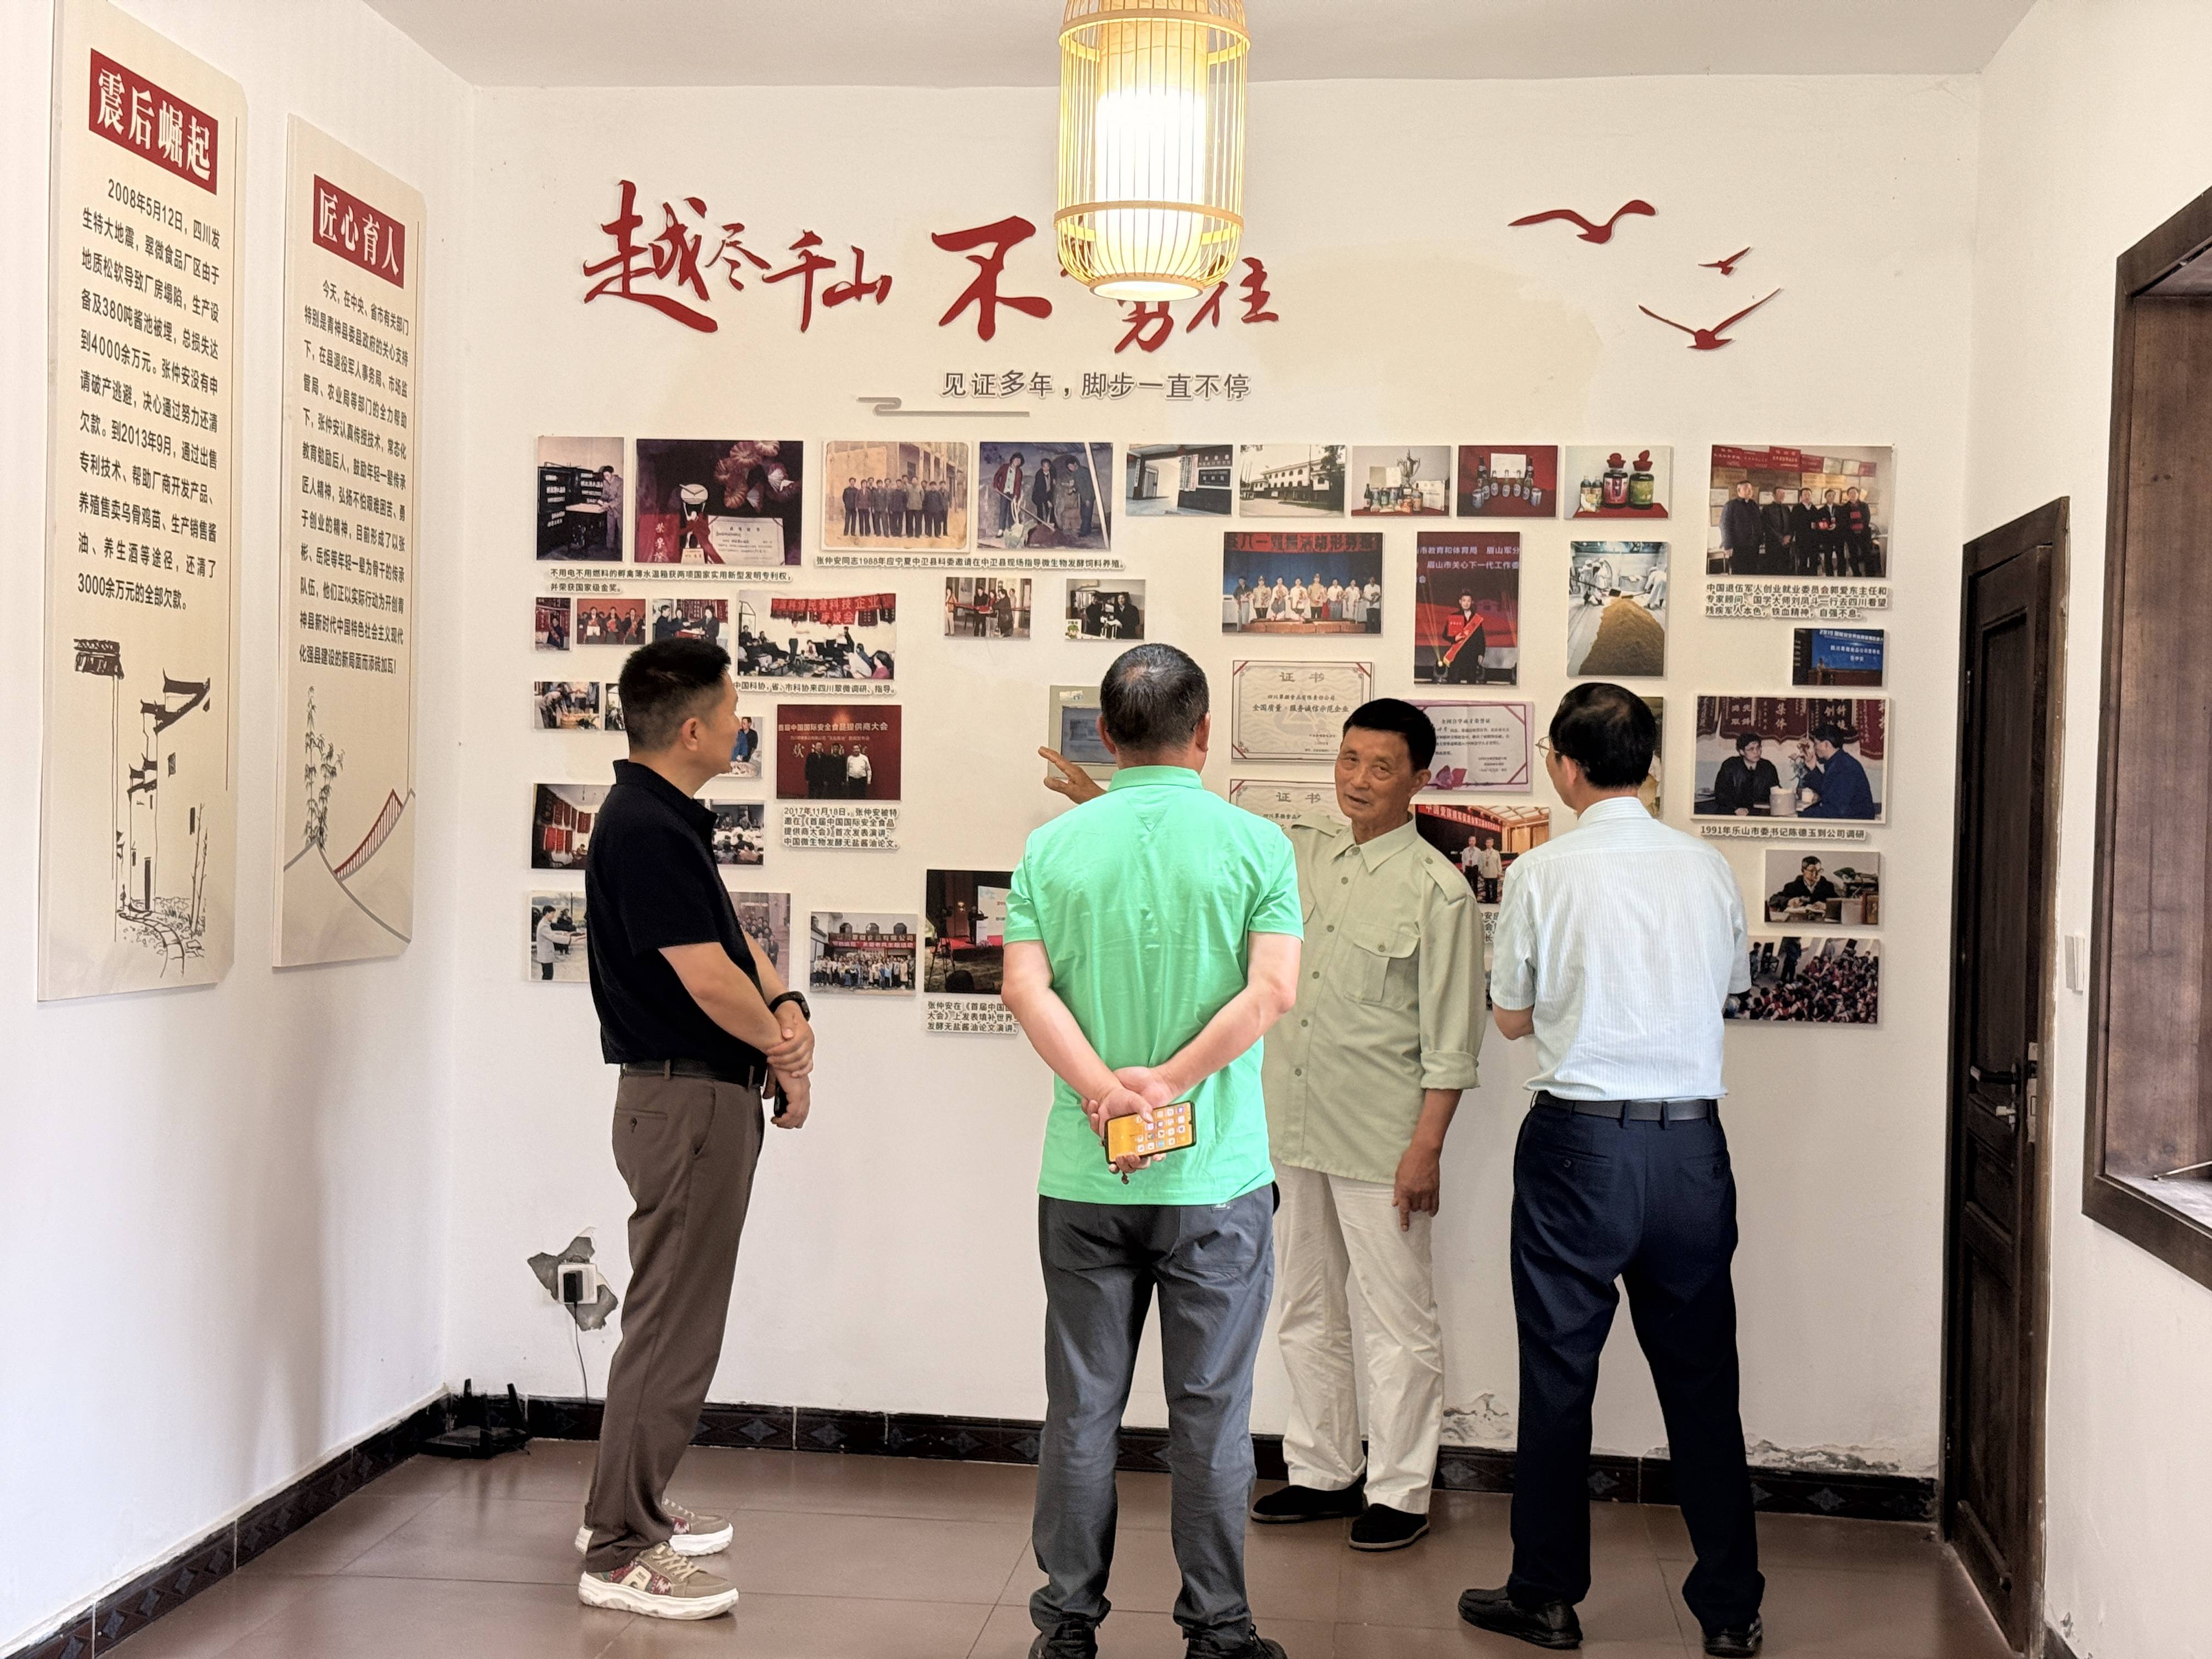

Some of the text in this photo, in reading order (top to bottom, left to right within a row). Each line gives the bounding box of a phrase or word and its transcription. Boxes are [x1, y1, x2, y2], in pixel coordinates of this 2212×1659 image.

[97, 67, 211, 181] 震后崛起
[108, 178, 221, 250] 2008年5月12日，四川发
[318, 187, 399, 277] 匠心育人
[82, 207, 220, 285] 生特大地震，翠微食品厂区由于
[81, 246, 219, 324] 地质松软导致厂房塌陷，生产设
[81, 288, 219, 360] 备及380吨酱池被埋，总损失达
[80, 329, 218, 397] 到4000余万元。张仲安没有申
[941, 371, 1250, 399] 见证多年，脚步一直不停
[80, 369, 218, 433] 请破产逃避，决心通过努力还清
[80, 409, 217, 470] 欠款。到2013年9月，通过出售
[79, 450, 213, 505] 专利技术、帮助厂商开发产品、
[78, 490, 217, 543] 养殖售卖乌骨鸡苗、生产销售酱
[78, 532, 216, 579] 油、养生酒等途径，还清了
[77, 572, 187, 611] 3000余万元的全部欠款。
[299, 610, 404, 645] 神县新时代中国特色社会主义现代
[1701, 825, 1865, 839] 1991年乐山市委书记陈德玉到公司调研
[927, 1011, 1019, 1022] 大会》上发表填补世界
